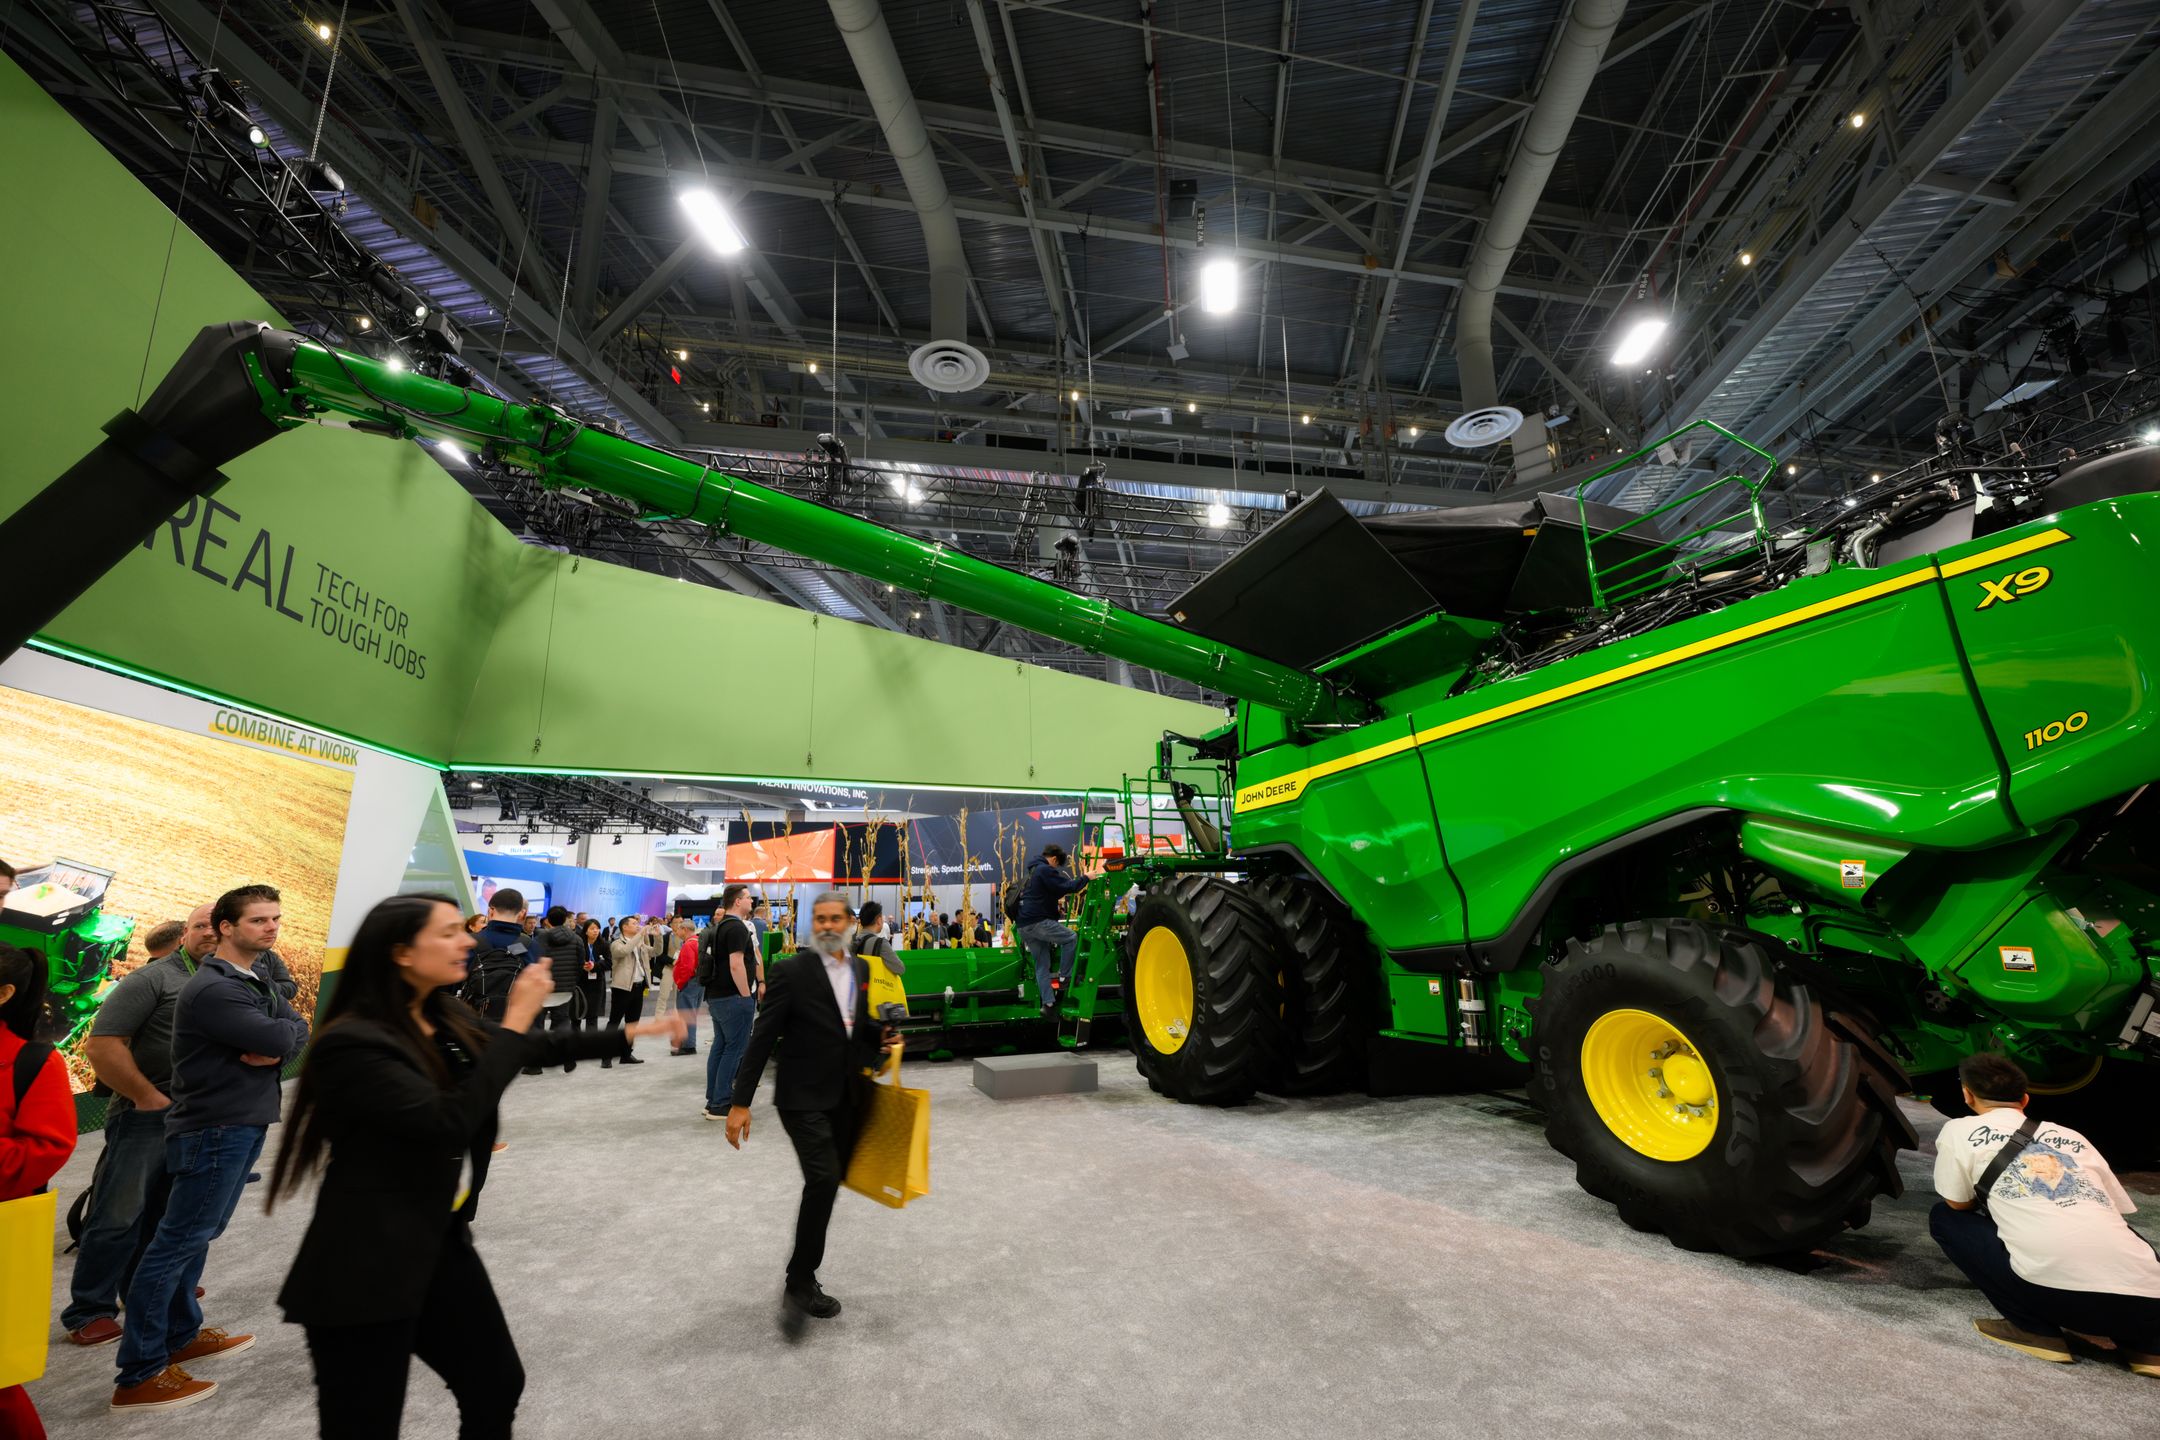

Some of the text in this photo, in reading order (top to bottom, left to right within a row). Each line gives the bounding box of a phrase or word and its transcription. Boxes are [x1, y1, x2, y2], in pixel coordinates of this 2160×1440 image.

[143, 494, 303, 623] REAL
[317, 562, 408, 639] TECH FOR
[1975, 565, 2053, 611] X9
[310, 597, 427, 680] TOUGH JOBS
[215, 710, 360, 766] COMBINE AT WORK
[2024, 711, 2089, 751] 1100
[852, 789, 868, 799] INC.
[1041, 808, 1079, 819] YAZAKI
[1241, 781, 1297, 805] JOHN DEERE
[941, 864, 964, 875] Speed.
